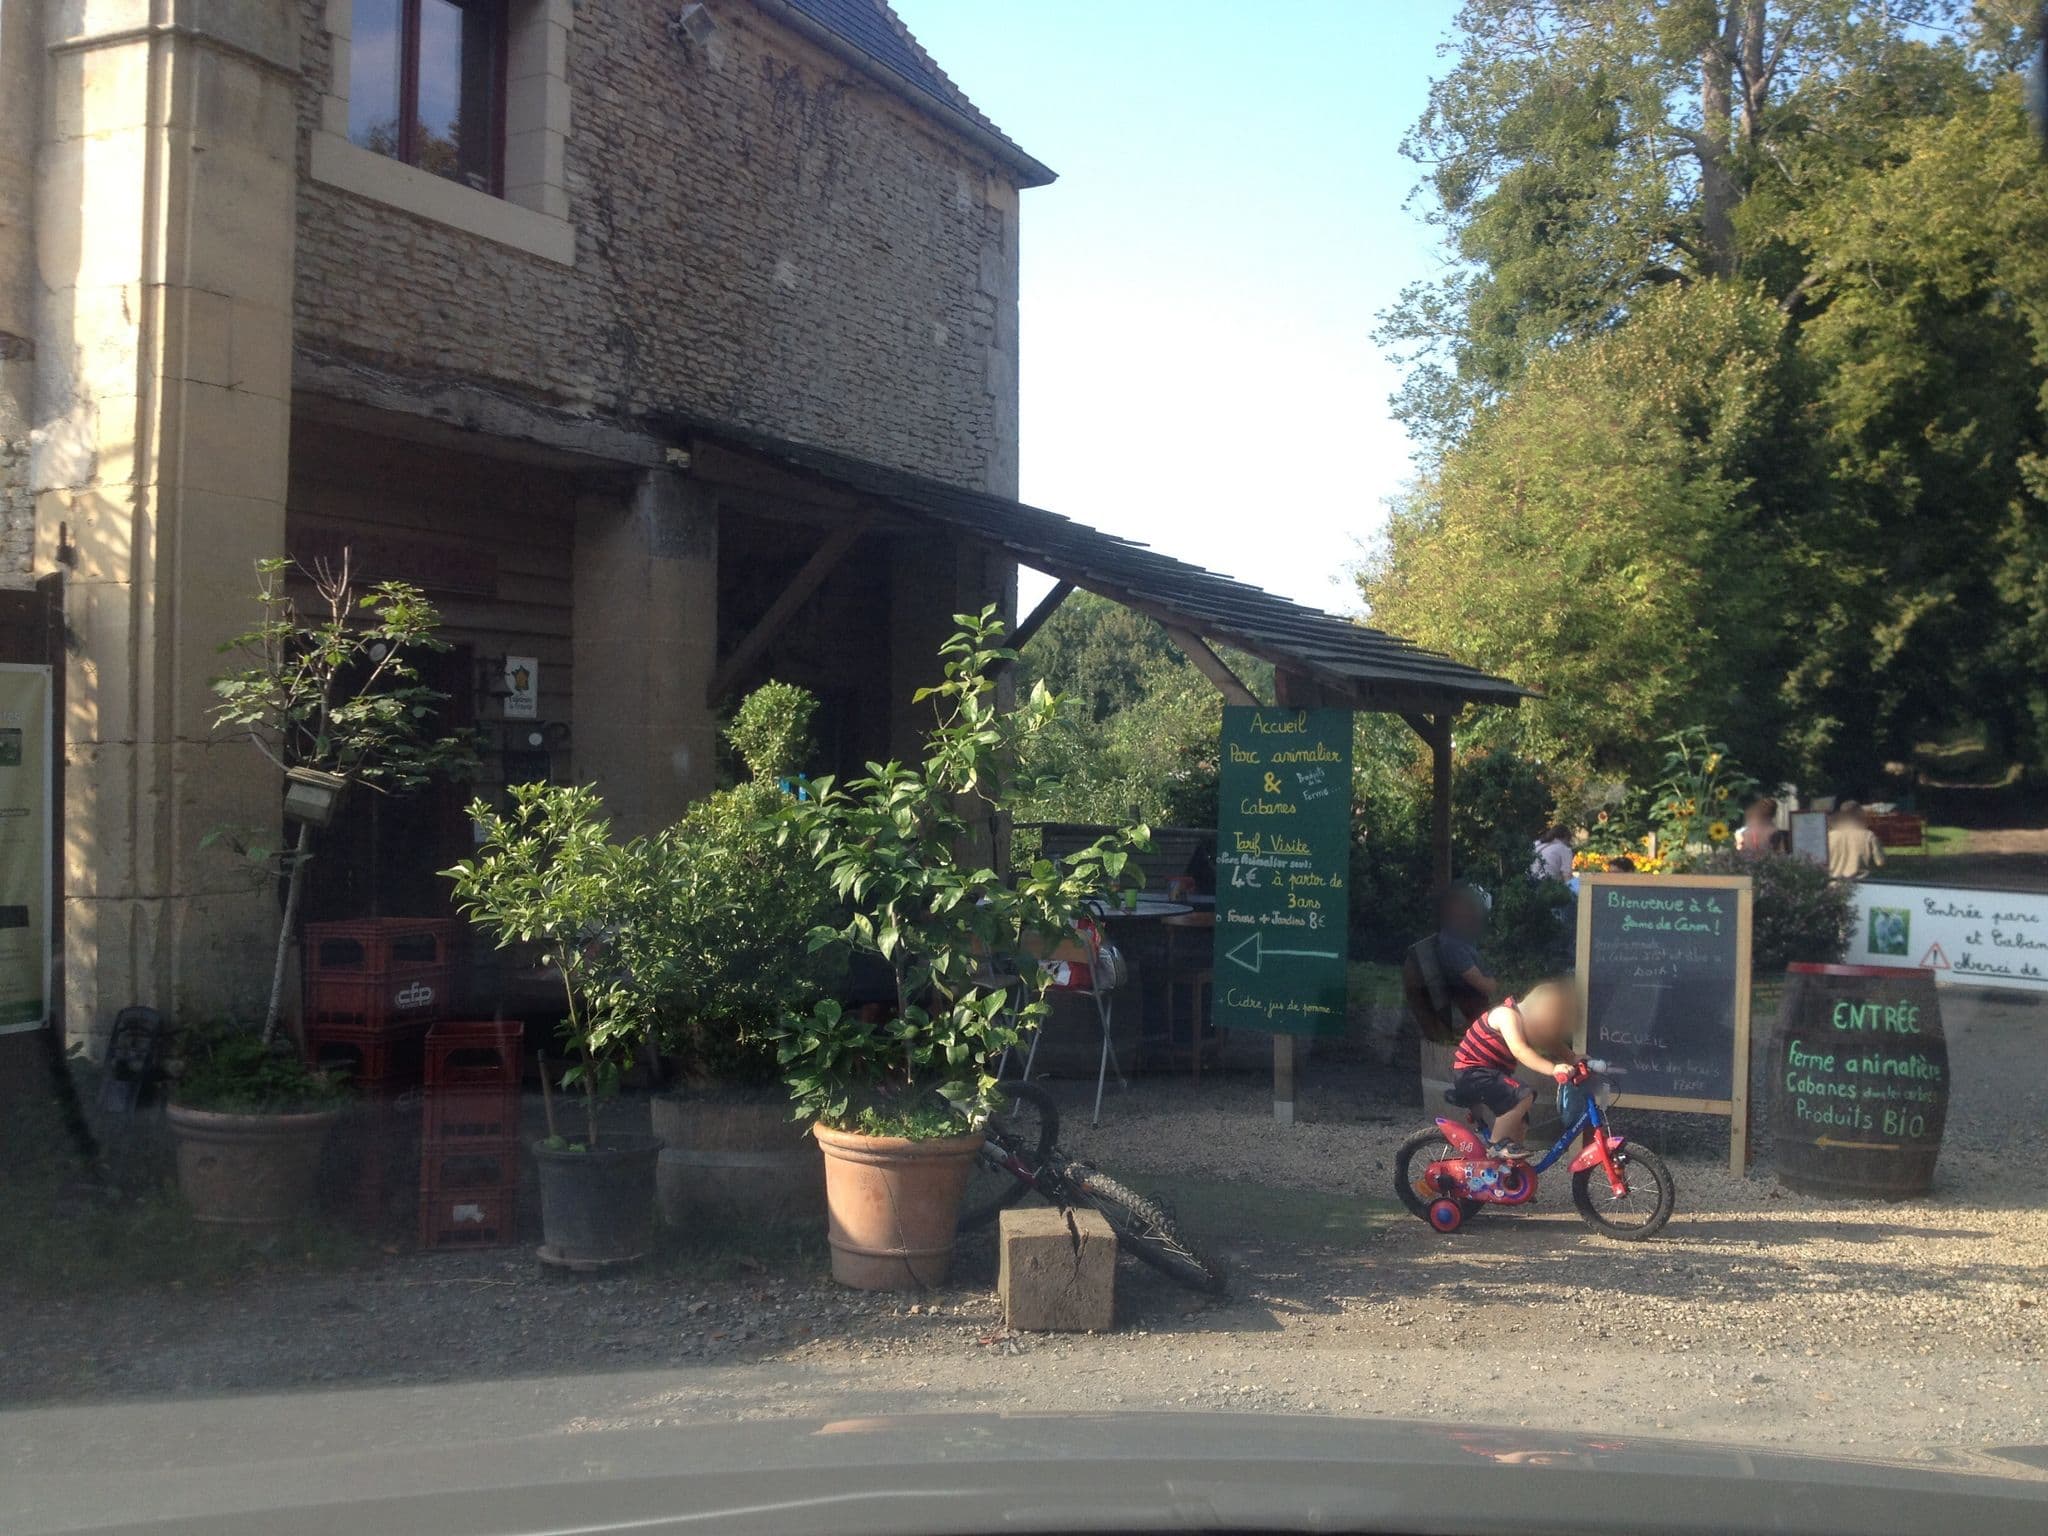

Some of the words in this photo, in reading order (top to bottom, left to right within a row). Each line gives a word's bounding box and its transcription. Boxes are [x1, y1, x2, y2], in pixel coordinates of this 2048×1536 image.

[1251, 712, 1308, 734] Accueil
[1230, 743, 1260, 764] Parc
[1271, 741, 1342, 764] animalier
[1264, 771, 1281, 794] &
[1241, 799, 1296, 815] Cabanes
[1234, 832, 1261, 856] Tarif
[1271, 834, 1311, 854] Visite
[1232, 866, 1262, 888] 4€
[1272, 870, 1283, 887] à
[1289, 872, 1326, 891] partir
[1330, 873, 1344, 888] de
[1607, 890, 1684, 912] Bienvenue
[1689, 897, 1701, 913] à
[1706, 896, 1723, 914] la
[1923, 897, 1983, 919] Entrée
[1992, 912, 2039, 926] parc
[1656, 916, 1671, 930] de
[1965, 930, 1983, 945] et
[1954, 952, 2011, 974] Merci
[2020, 962, 2041, 976] de
[1267, 999, 1284, 1019] jus
[1287, 999, 1300, 1012] de
[1833, 1000, 1921, 1034] ENTRÉE
[1599, 1025, 1668, 1049] ACCUEIL
[1788, 1040, 1834, 1072] Ferme
[1786, 1071, 1857, 1099] Cabanes
[1797, 1098, 1873, 1130] Produits
